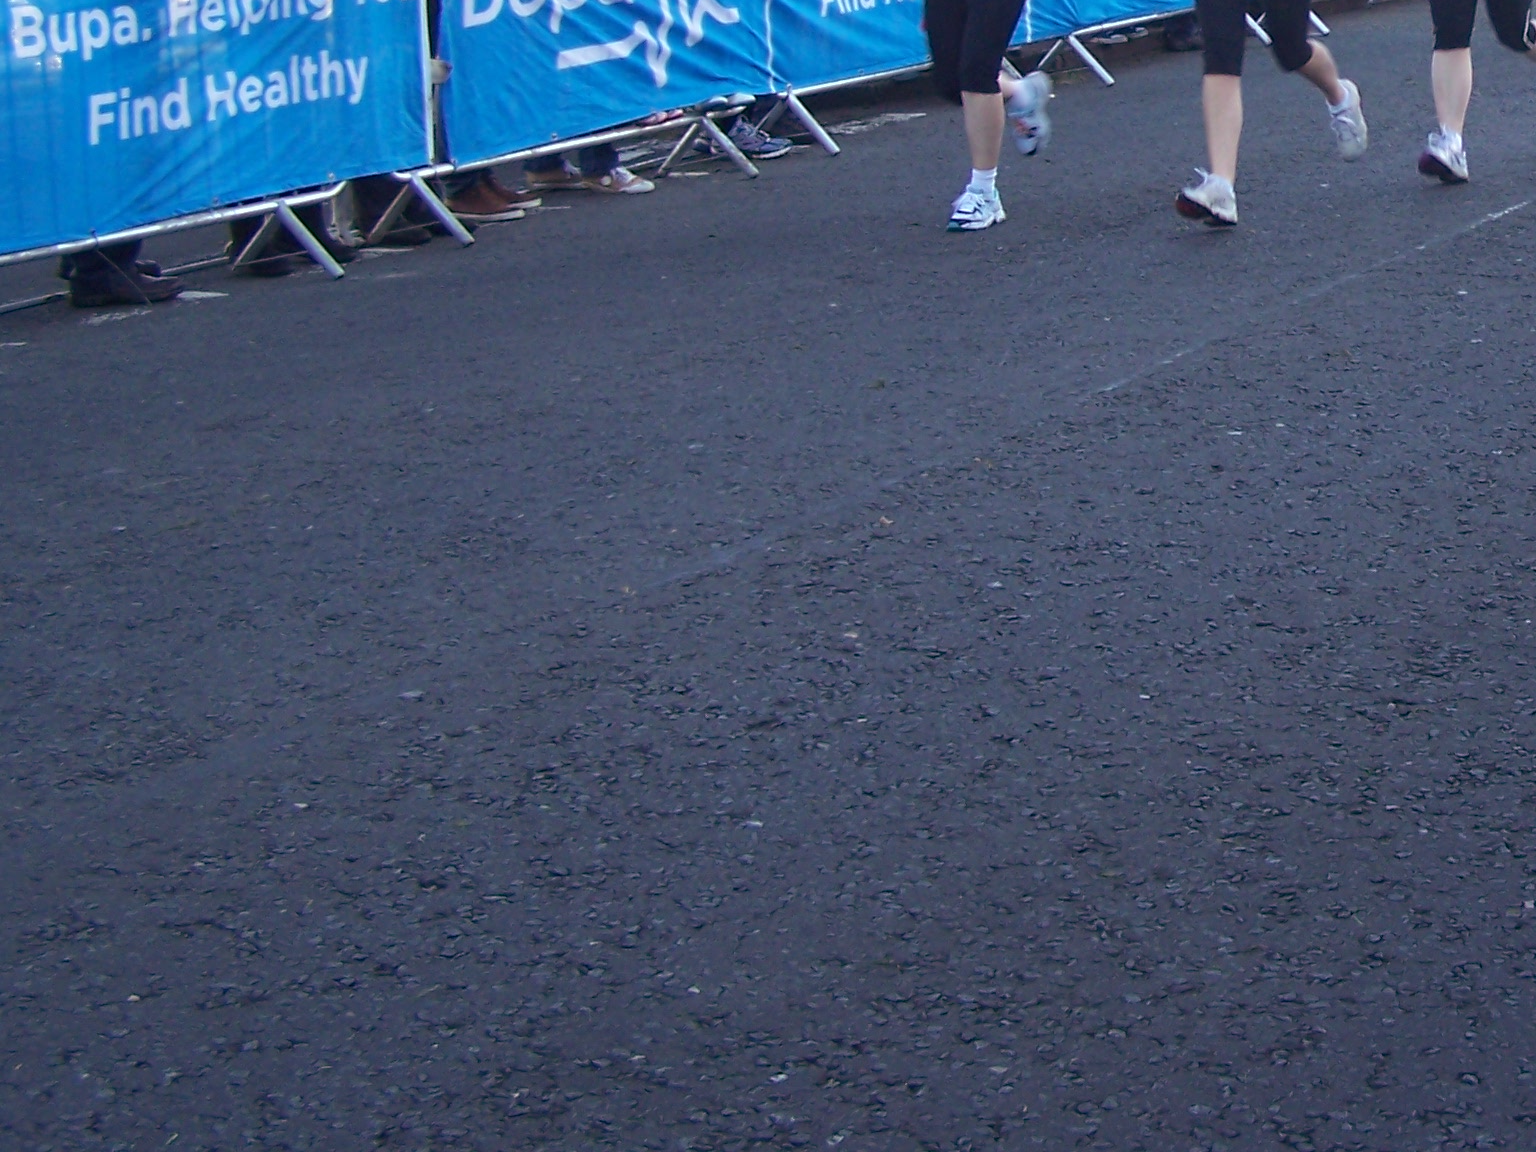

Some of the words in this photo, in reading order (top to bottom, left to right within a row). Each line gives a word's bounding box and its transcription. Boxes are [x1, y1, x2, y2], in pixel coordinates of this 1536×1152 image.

[11, 4, 152, 62] Bupa.
[89, 76, 192, 146] Find
[205, 50, 369, 122] Healthy
